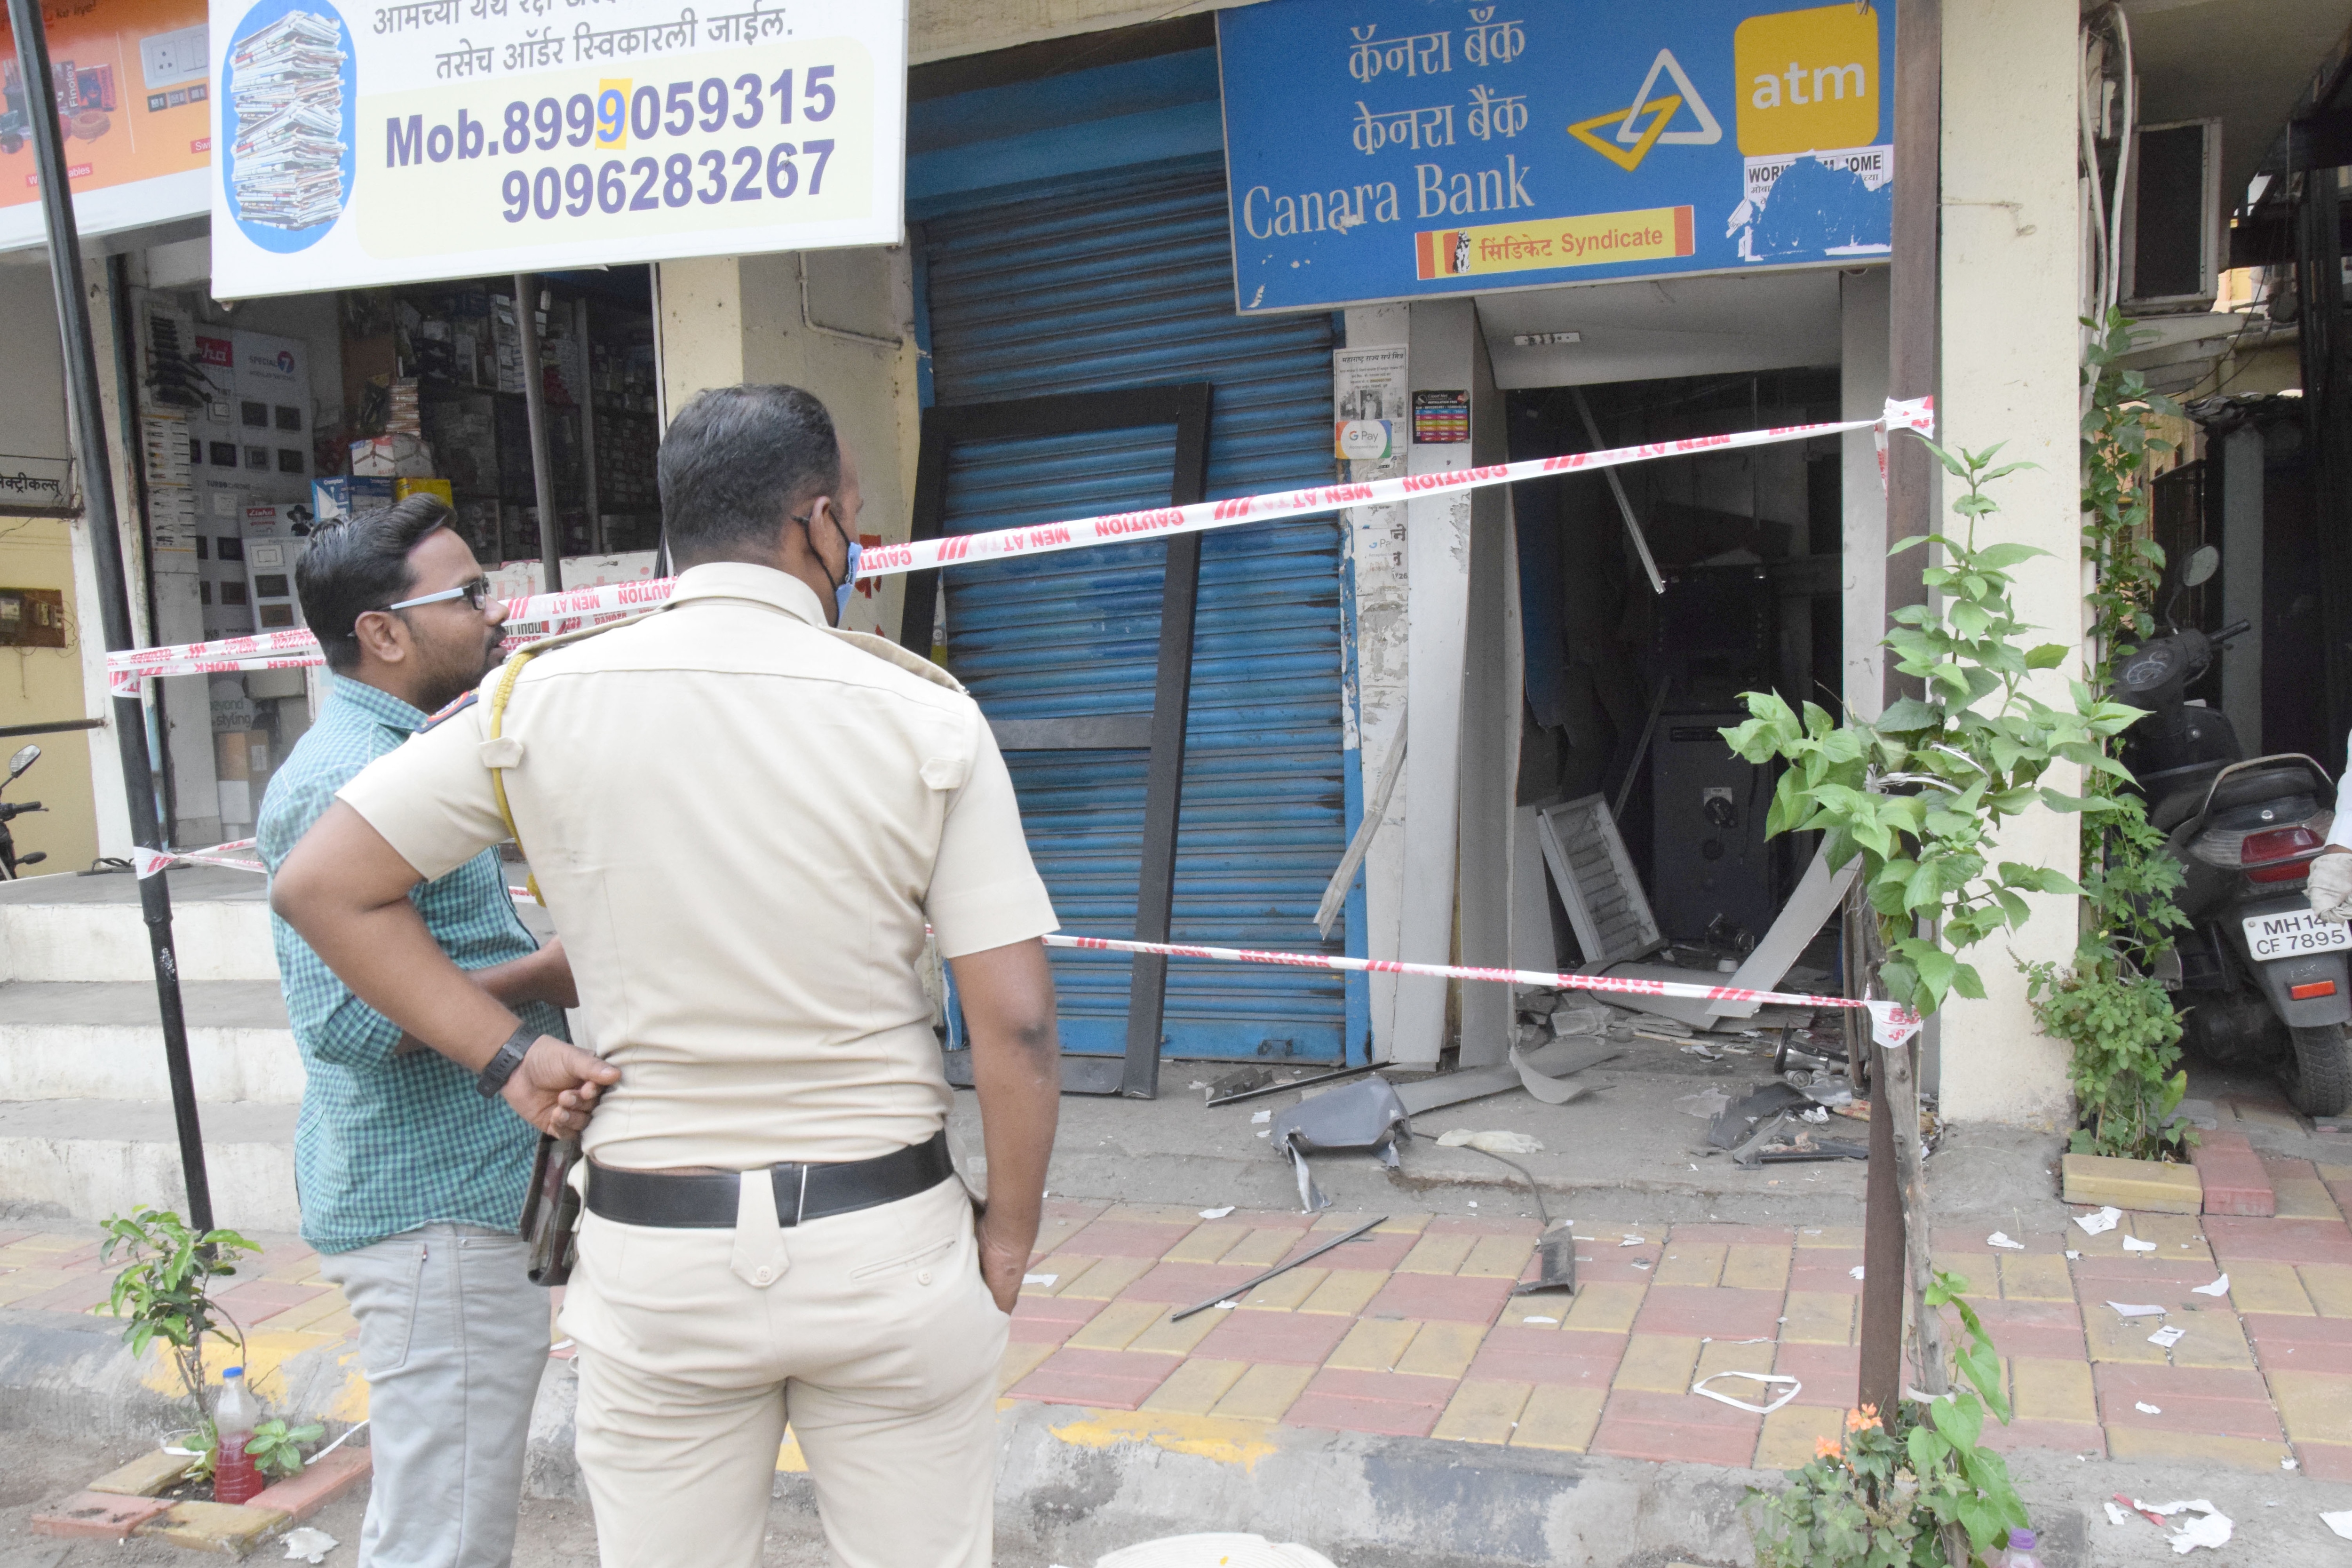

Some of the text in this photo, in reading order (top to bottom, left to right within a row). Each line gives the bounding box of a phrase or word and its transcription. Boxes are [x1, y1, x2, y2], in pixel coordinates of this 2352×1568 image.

[435, 0, 793, 79] तसेच ऑर्डर स्विकारली जाईल.
[1348, 24, 1453, 83] कॅनरा
[65, 63, 79, 108] Finolex
[1752, 56, 1866, 111] atm
[385, 65, 837, 169] Mob.8999059315
[1352, 84, 1528, 155] केनरा बैंक
[68, 166, 90, 177] ables
[1846, 154, 1881, 171] OME
[501, 139, 837, 224] 9096283267
[1243, 154, 1535, 240] Canara Bank
[1478, 233, 1553, 262] सिंडिकेट
[1561, 226, 1663, 257] Syndicate
[1361, 431, 1378, 442] Pay
[1402, 464, 1509, 493] CAUTION
[1293, 484, 1374, 509] MEN AT
[1095, 508, 1184, 537] CAUTION
[1003, 527, 1071, 552] MEN AT
[1380, 539, 1392, 548] Pa
[857, 549, 912, 572] CAUTI
[552, 595, 601, 614] MEN AT
[618, 582, 676, 605] AUTION
[194, 661, 240, 672] WORK
[267, 659, 325, 669] ANGER
[2263, 915, 2327, 936] MH 14
[2286, 929, 2345, 950] 7895
